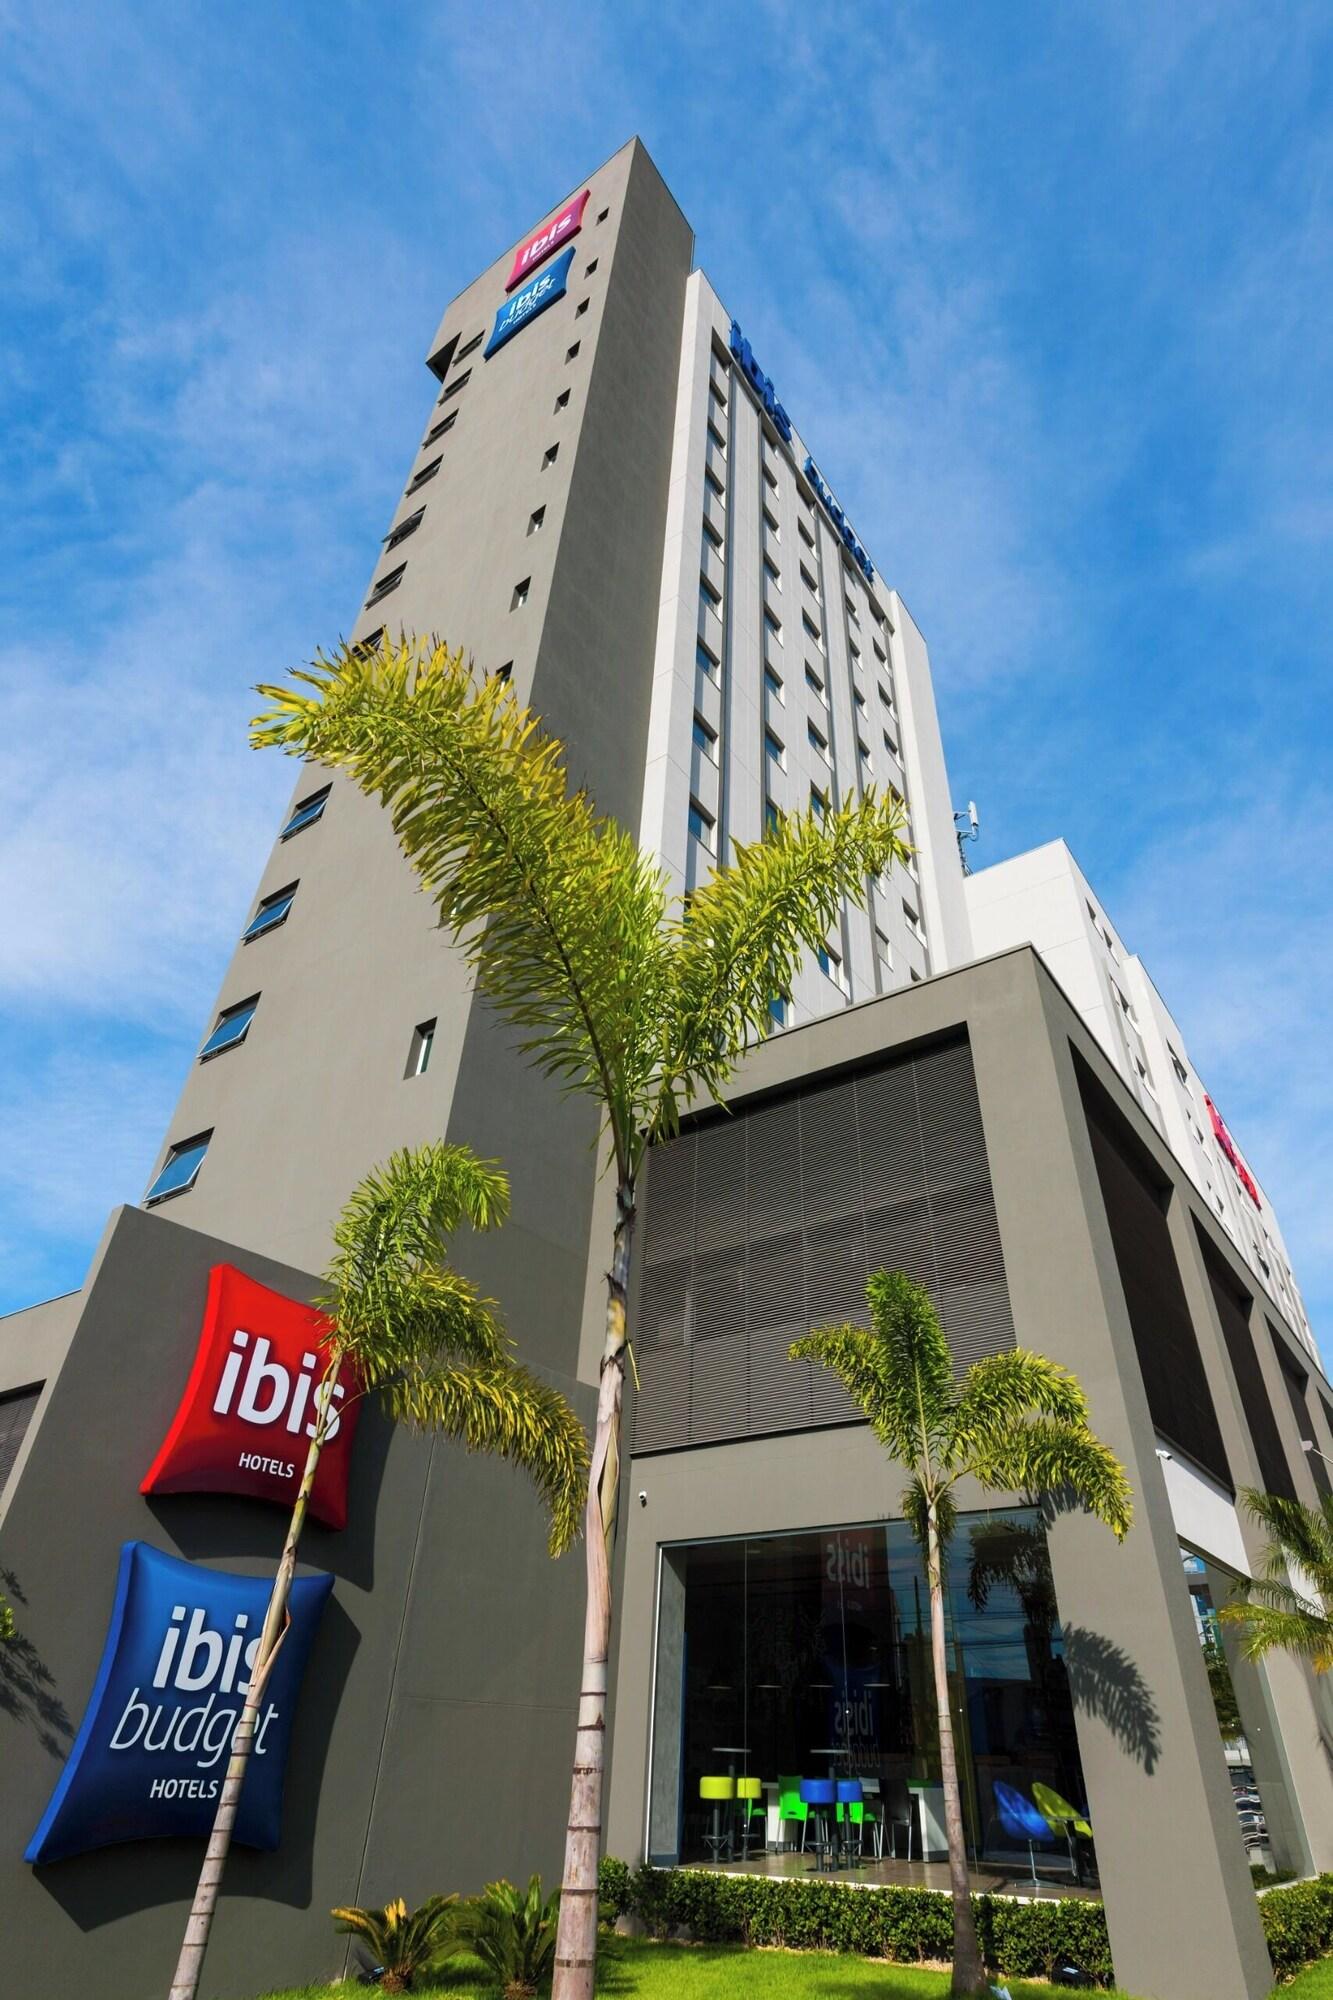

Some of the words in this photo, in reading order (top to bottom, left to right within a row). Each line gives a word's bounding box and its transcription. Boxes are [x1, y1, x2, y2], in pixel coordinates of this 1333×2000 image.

[521, 214, 572, 266] ibis
[509, 274, 551, 316] ibis
[213, 1329, 345, 1441] ibis
[238, 1452, 295, 1478] HOTELS
[109, 1687, 279, 1768] budgt
[150, 1779, 219, 1798] HOTELS
